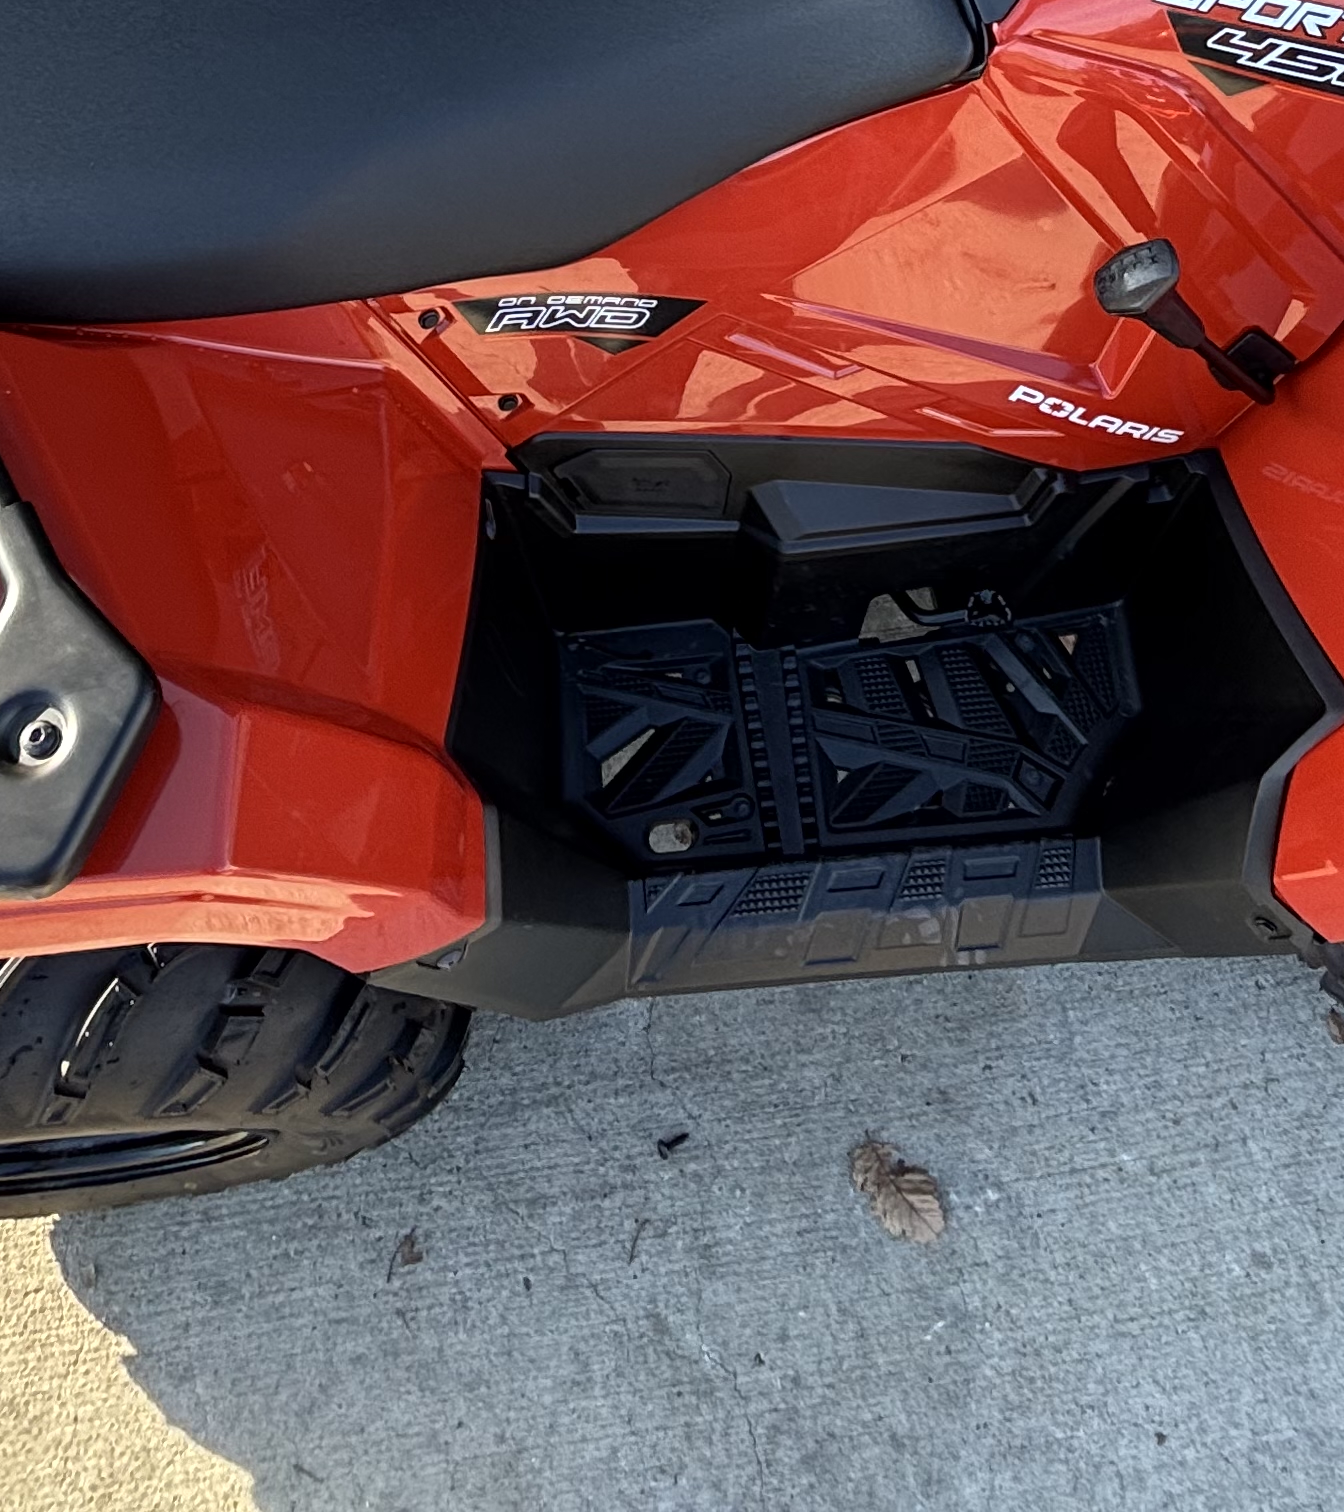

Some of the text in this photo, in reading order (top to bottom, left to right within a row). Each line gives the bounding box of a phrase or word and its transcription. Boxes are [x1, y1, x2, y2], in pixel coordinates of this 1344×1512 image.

[498, 296, 658, 308] ON DEMAND
[485, 305, 651, 333] AWD
[1008, 385, 1184, 444] POLARIS
